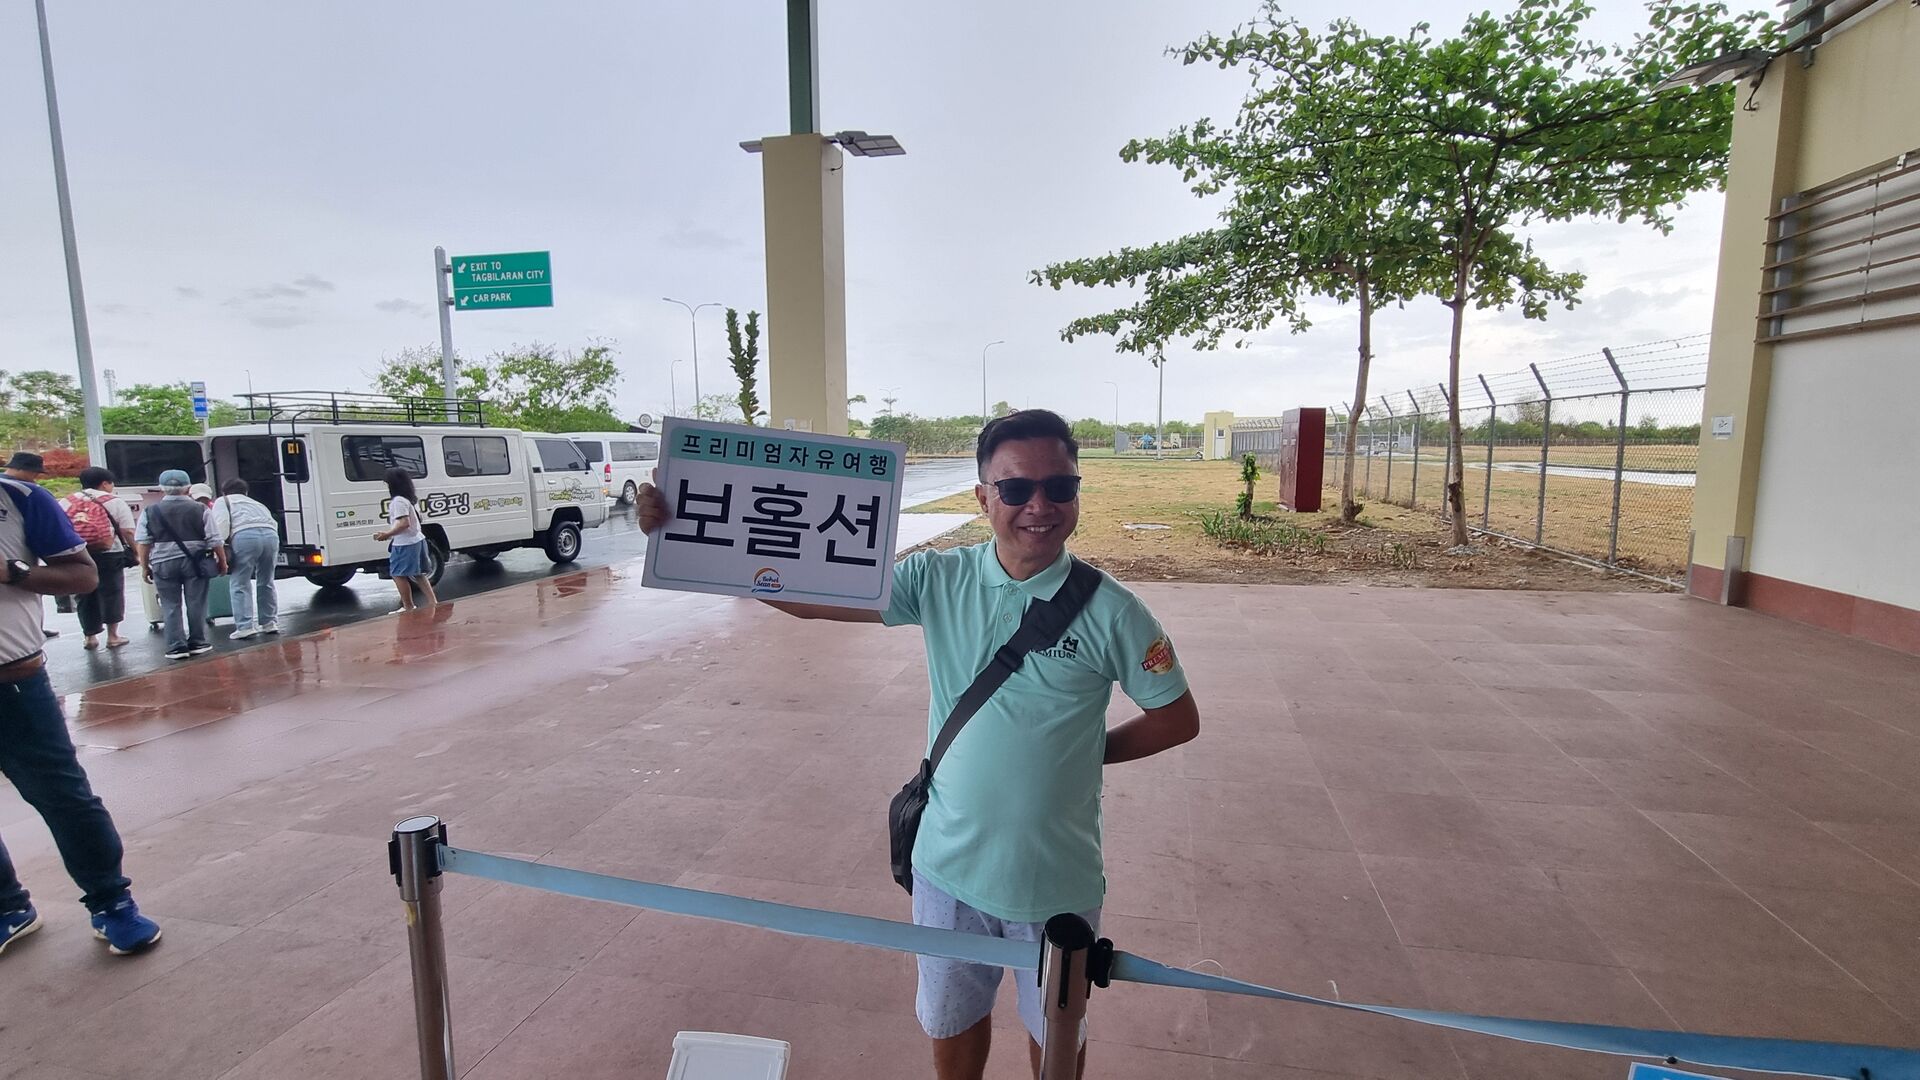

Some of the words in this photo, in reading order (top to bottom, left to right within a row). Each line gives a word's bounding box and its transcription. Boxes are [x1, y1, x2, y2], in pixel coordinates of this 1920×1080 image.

[470, 262, 487, 272] EXIT
[491, 261, 502, 271] TO
[471, 271, 524, 282] TAGBILARAN
[526, 269, 545, 280] CITY
[473, 294, 489, 303] CAR
[490, 292, 512, 302] PARK
[681, 434, 888, 476] 프리미엄자유여행
[664, 478, 881, 567] 보홀션
